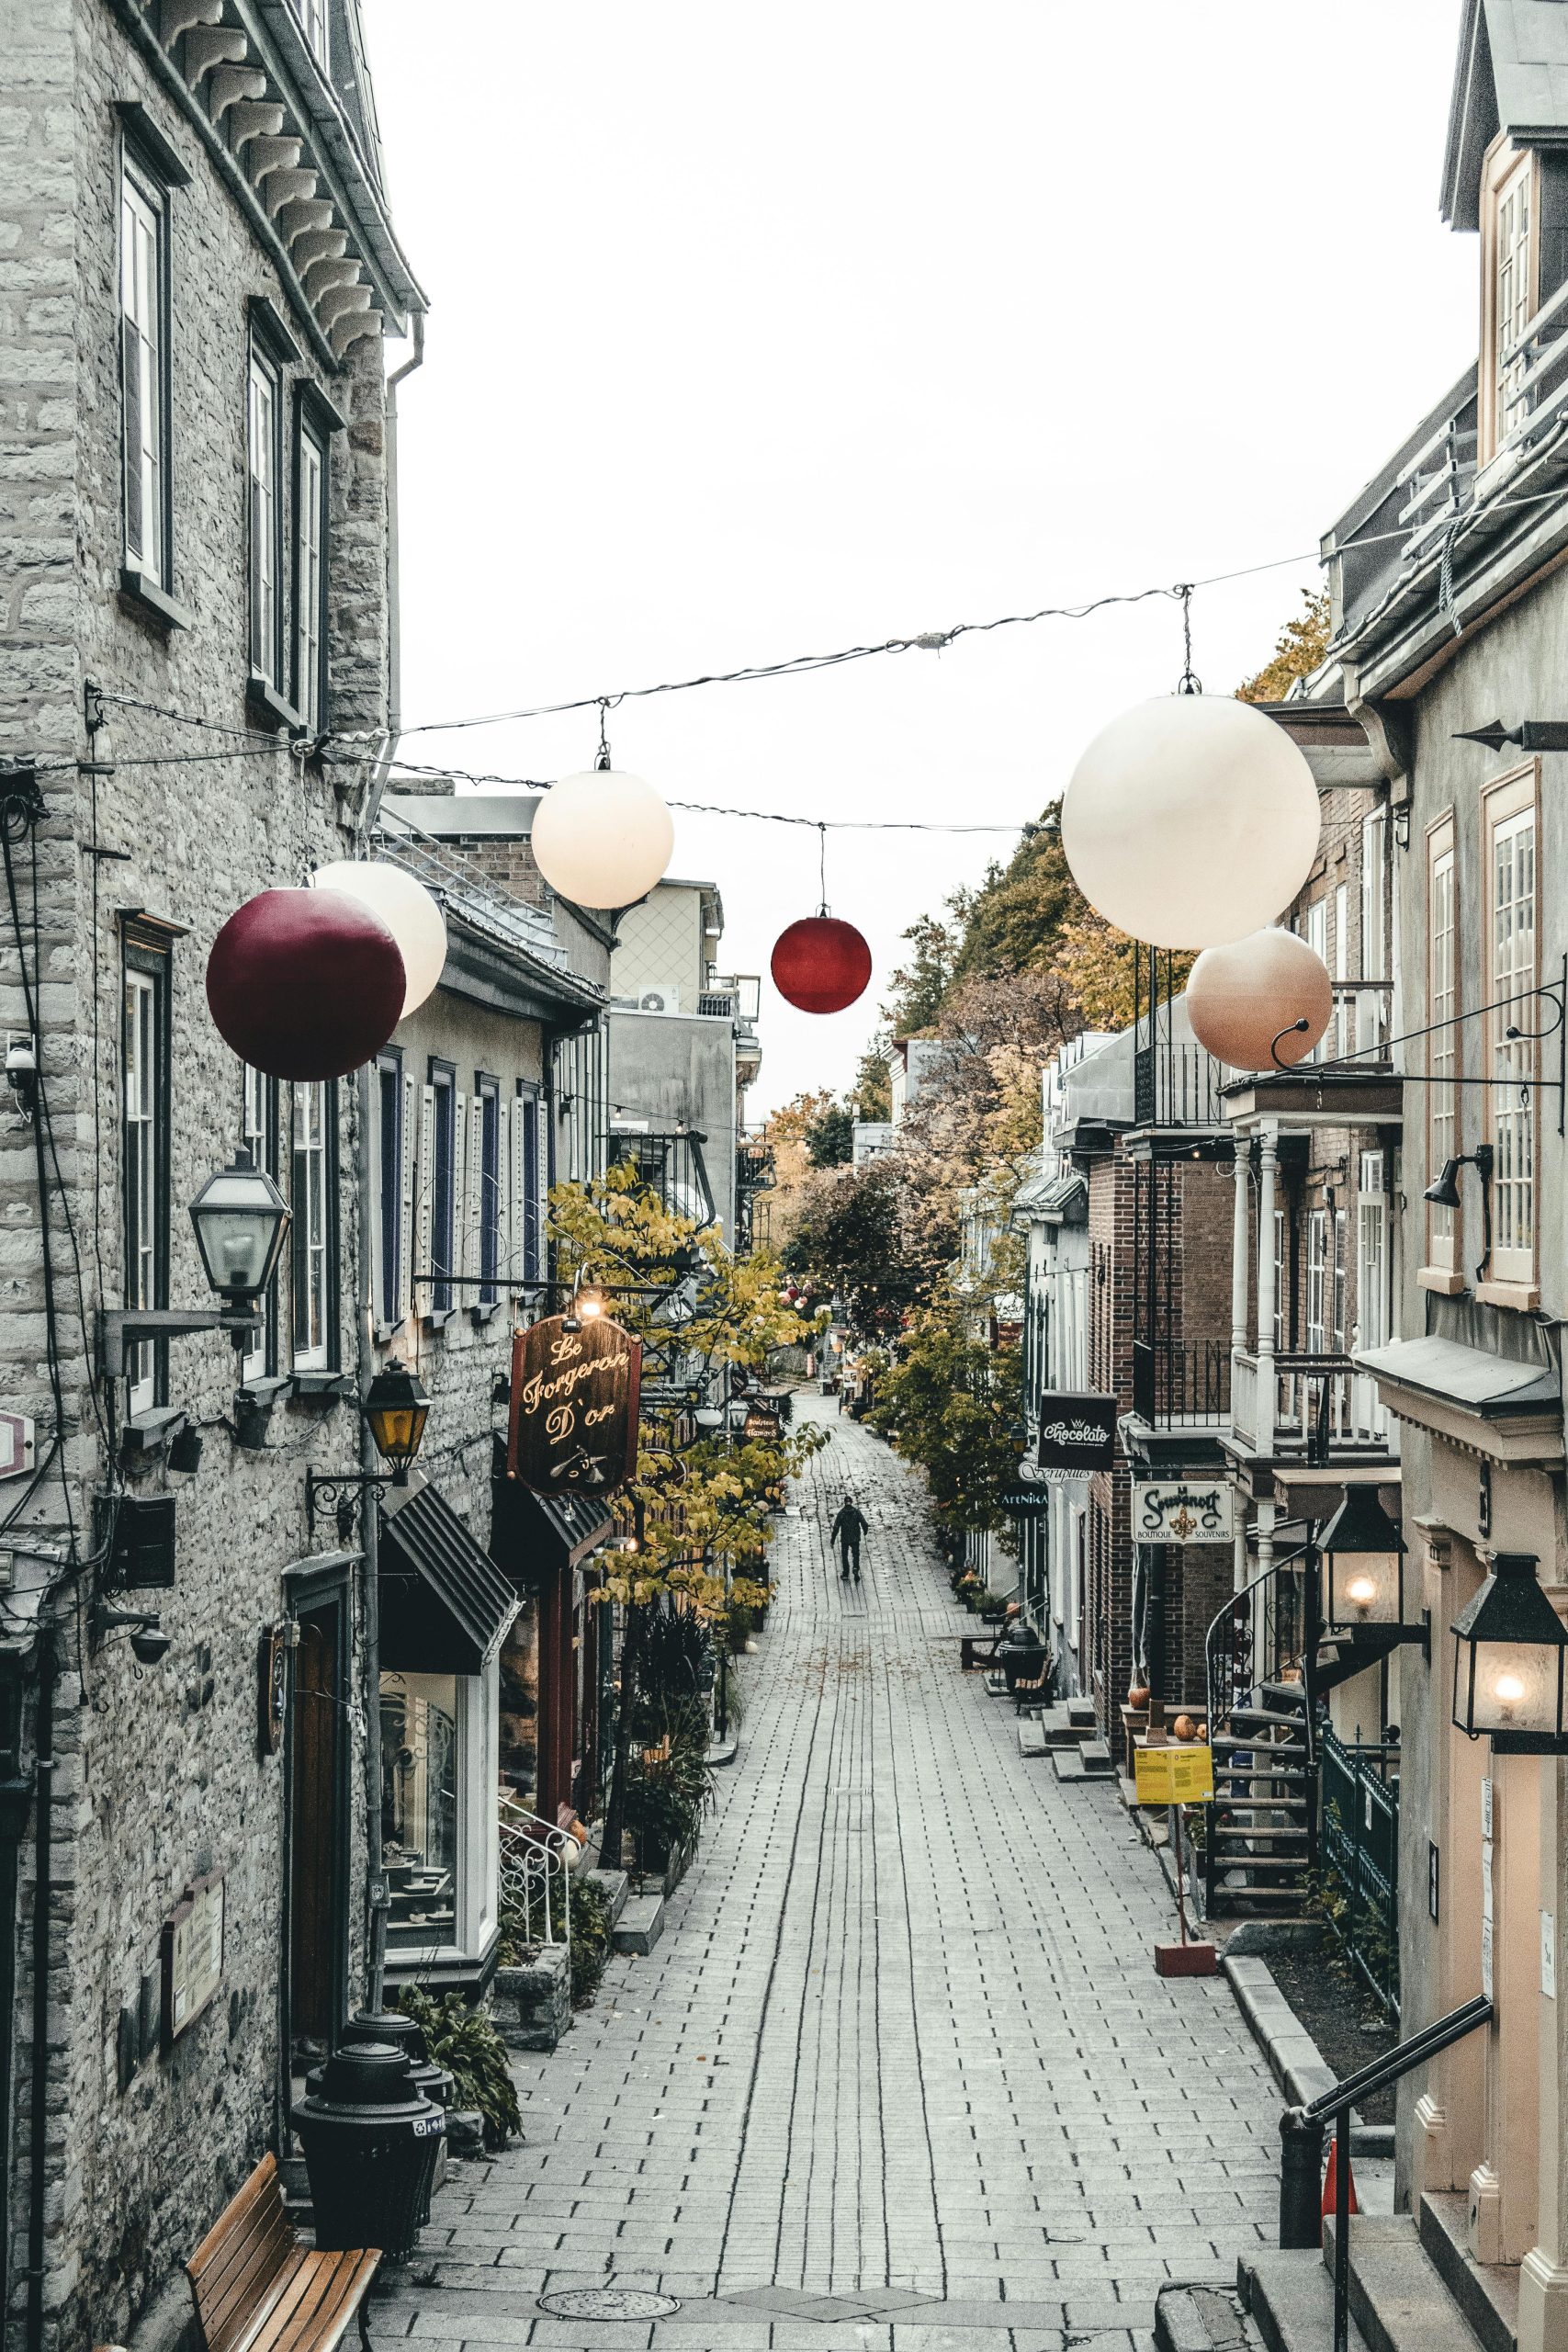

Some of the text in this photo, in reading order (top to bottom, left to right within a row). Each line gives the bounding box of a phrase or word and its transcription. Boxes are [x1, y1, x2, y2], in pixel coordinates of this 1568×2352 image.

[551, 1336, 582, 1365] Le
[523, 1351, 630, 1415] Forgeron
[1043, 1421, 1111, 1445] Chocolato
[1137, 1531, 1230, 1539] BOUTIQUE SOUVENIRS
